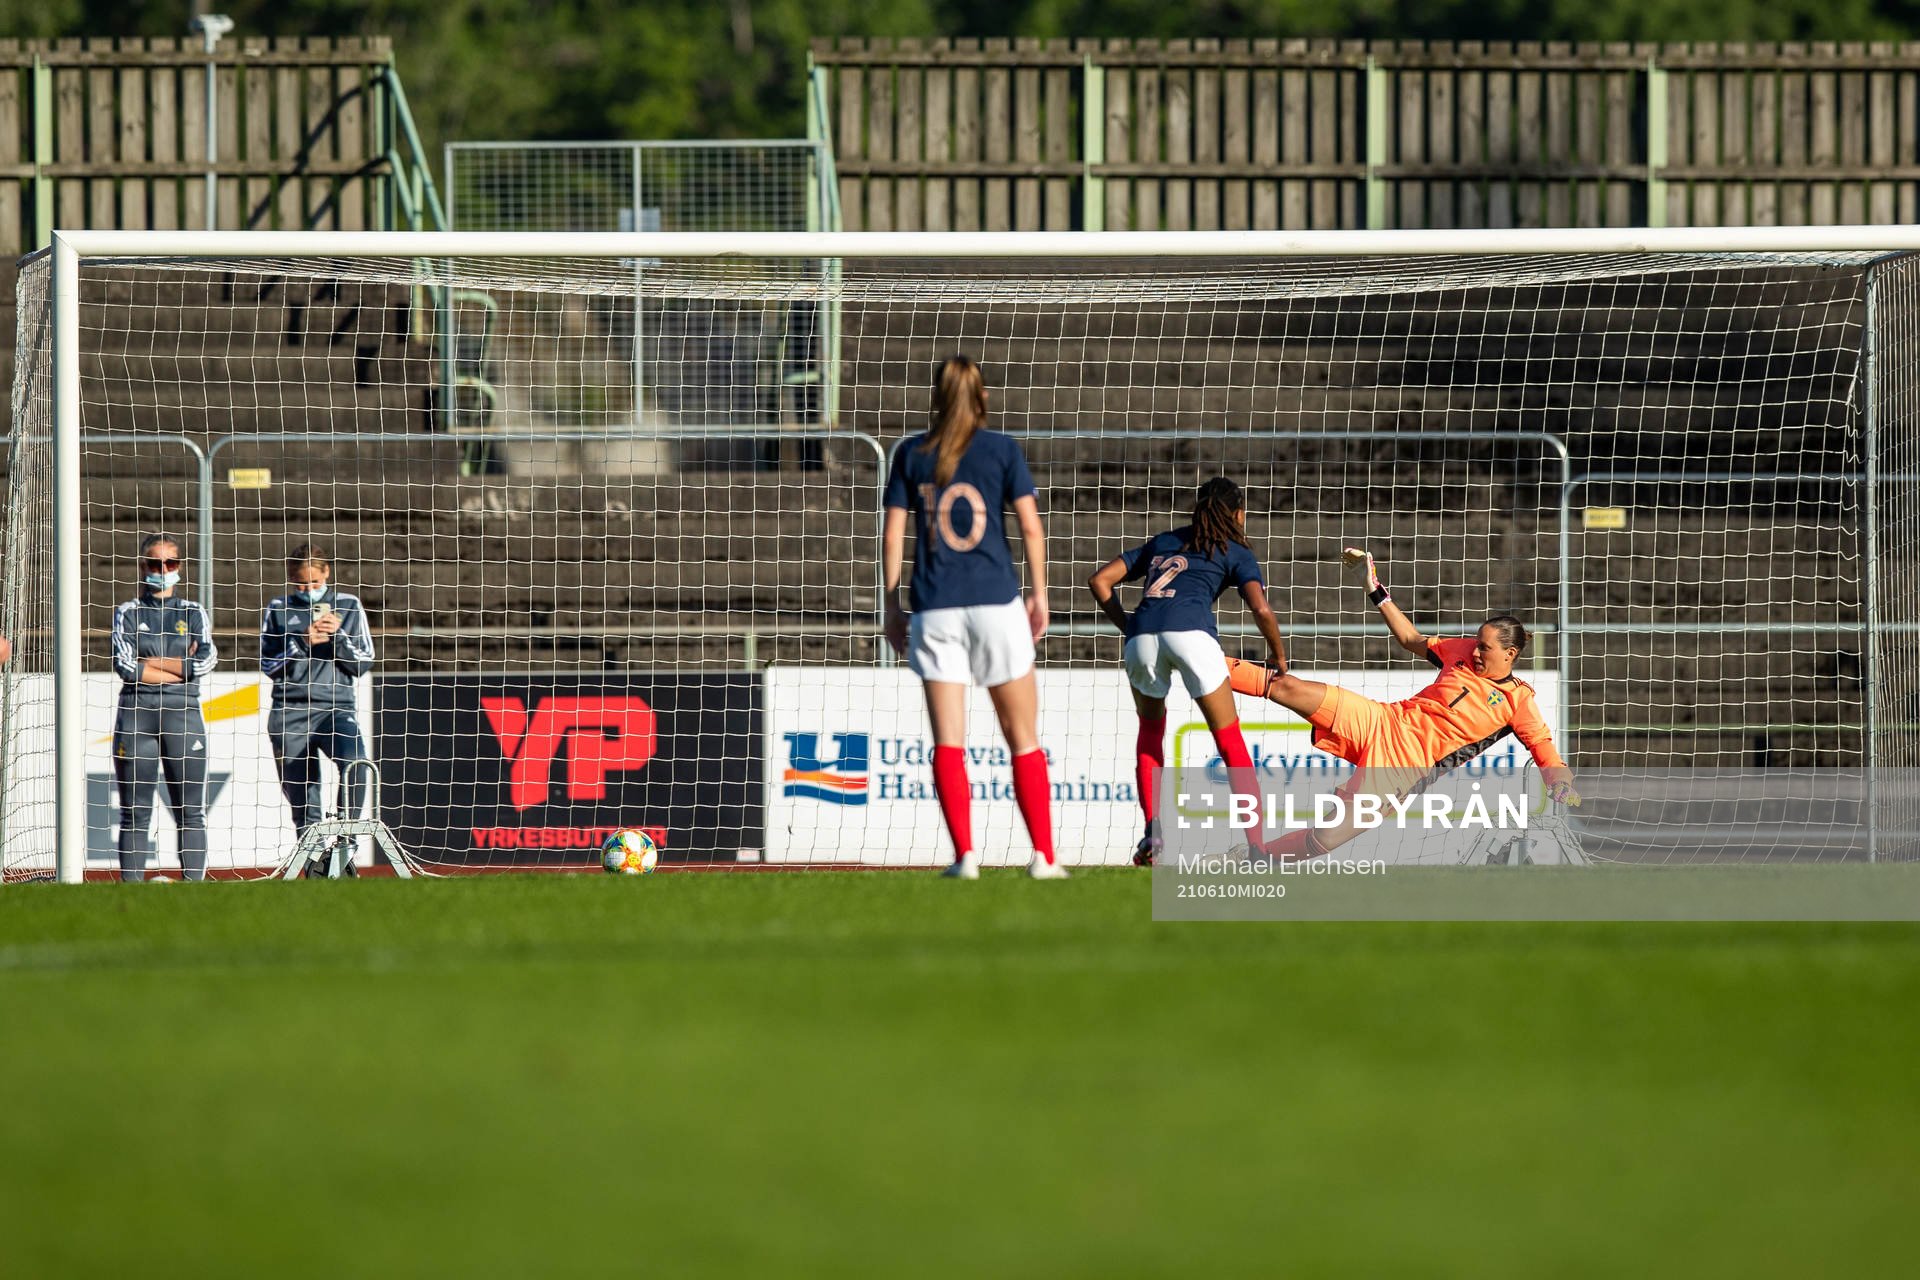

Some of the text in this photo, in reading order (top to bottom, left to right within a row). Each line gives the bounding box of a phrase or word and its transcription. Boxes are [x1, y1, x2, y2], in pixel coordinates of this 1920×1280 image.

[918, 482, 988, 552] 10
[480, 696, 658, 812] YP
[471, 825, 667, 849] YRKESBUTR
